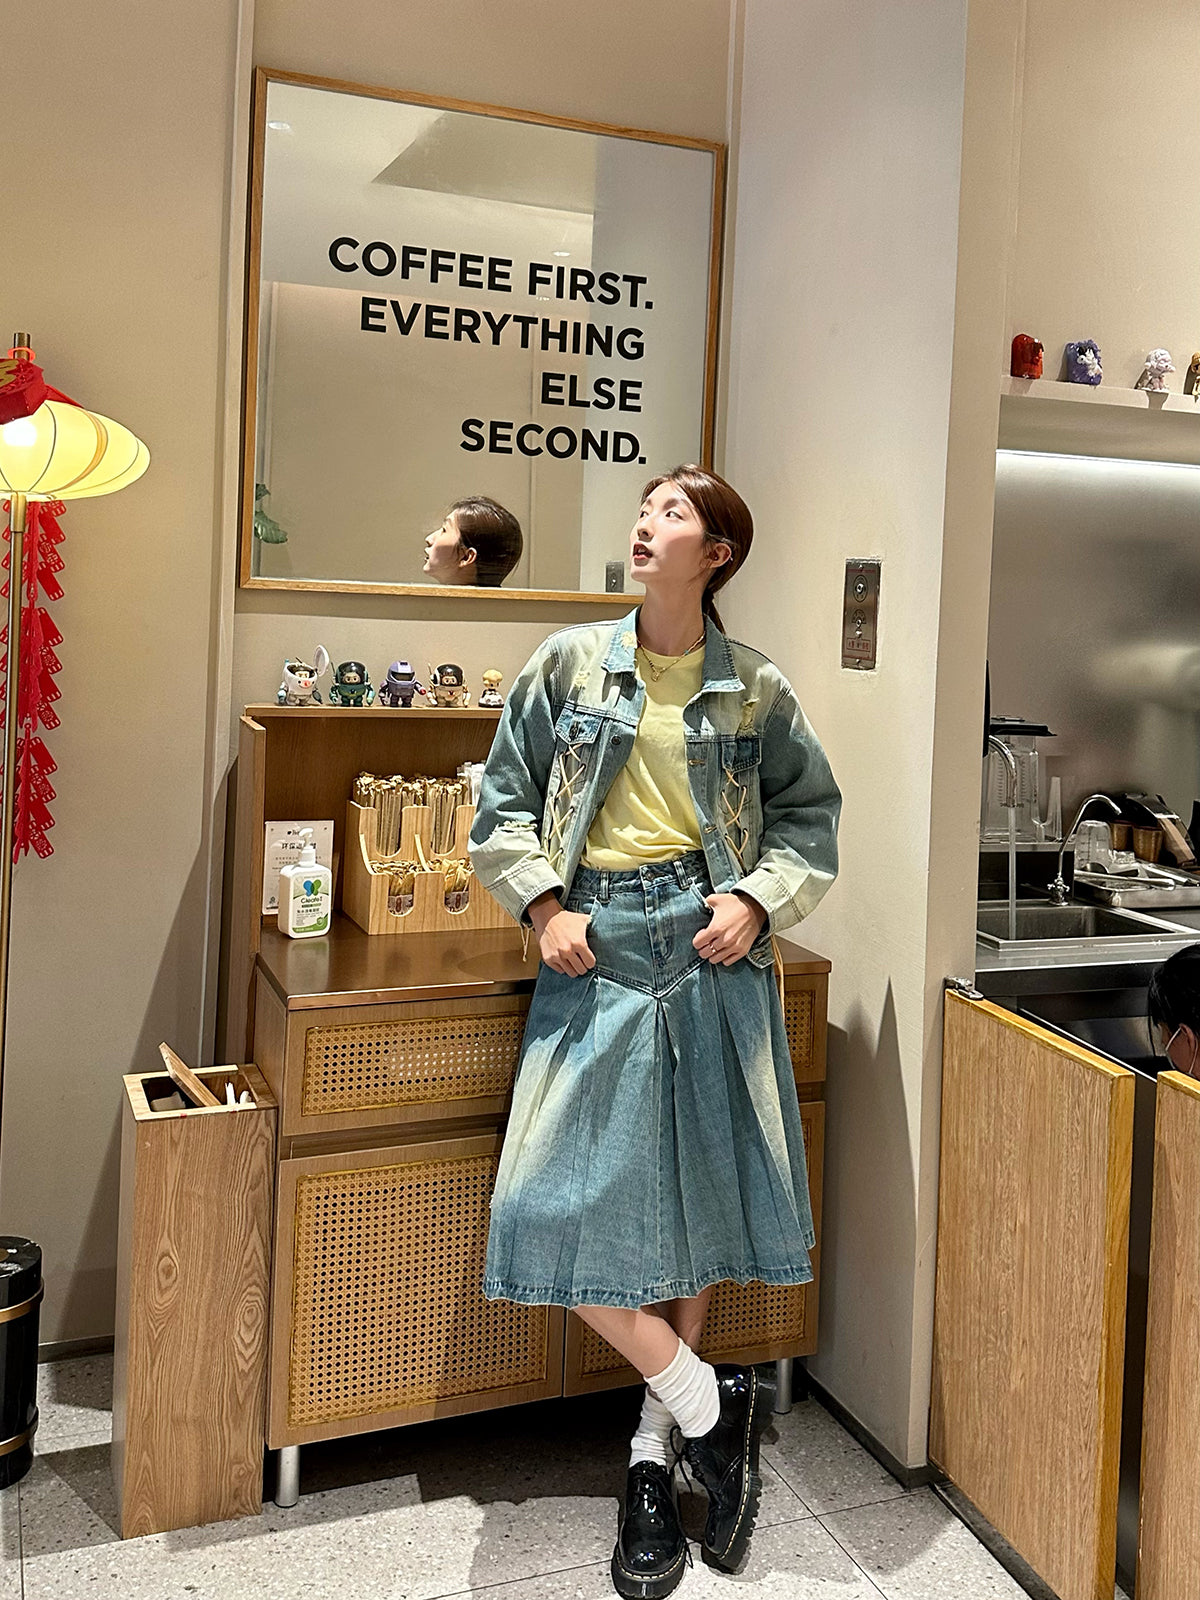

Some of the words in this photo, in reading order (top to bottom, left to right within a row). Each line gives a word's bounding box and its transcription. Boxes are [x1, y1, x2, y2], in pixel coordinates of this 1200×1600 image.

[328, 236, 513, 293] COFFEE
[528, 262, 654, 310] FIRST.
[360, 296, 645, 361] EVERYTHING
[540, 371, 643, 413] ELSE
[459, 418, 647, 465] SECOND.
